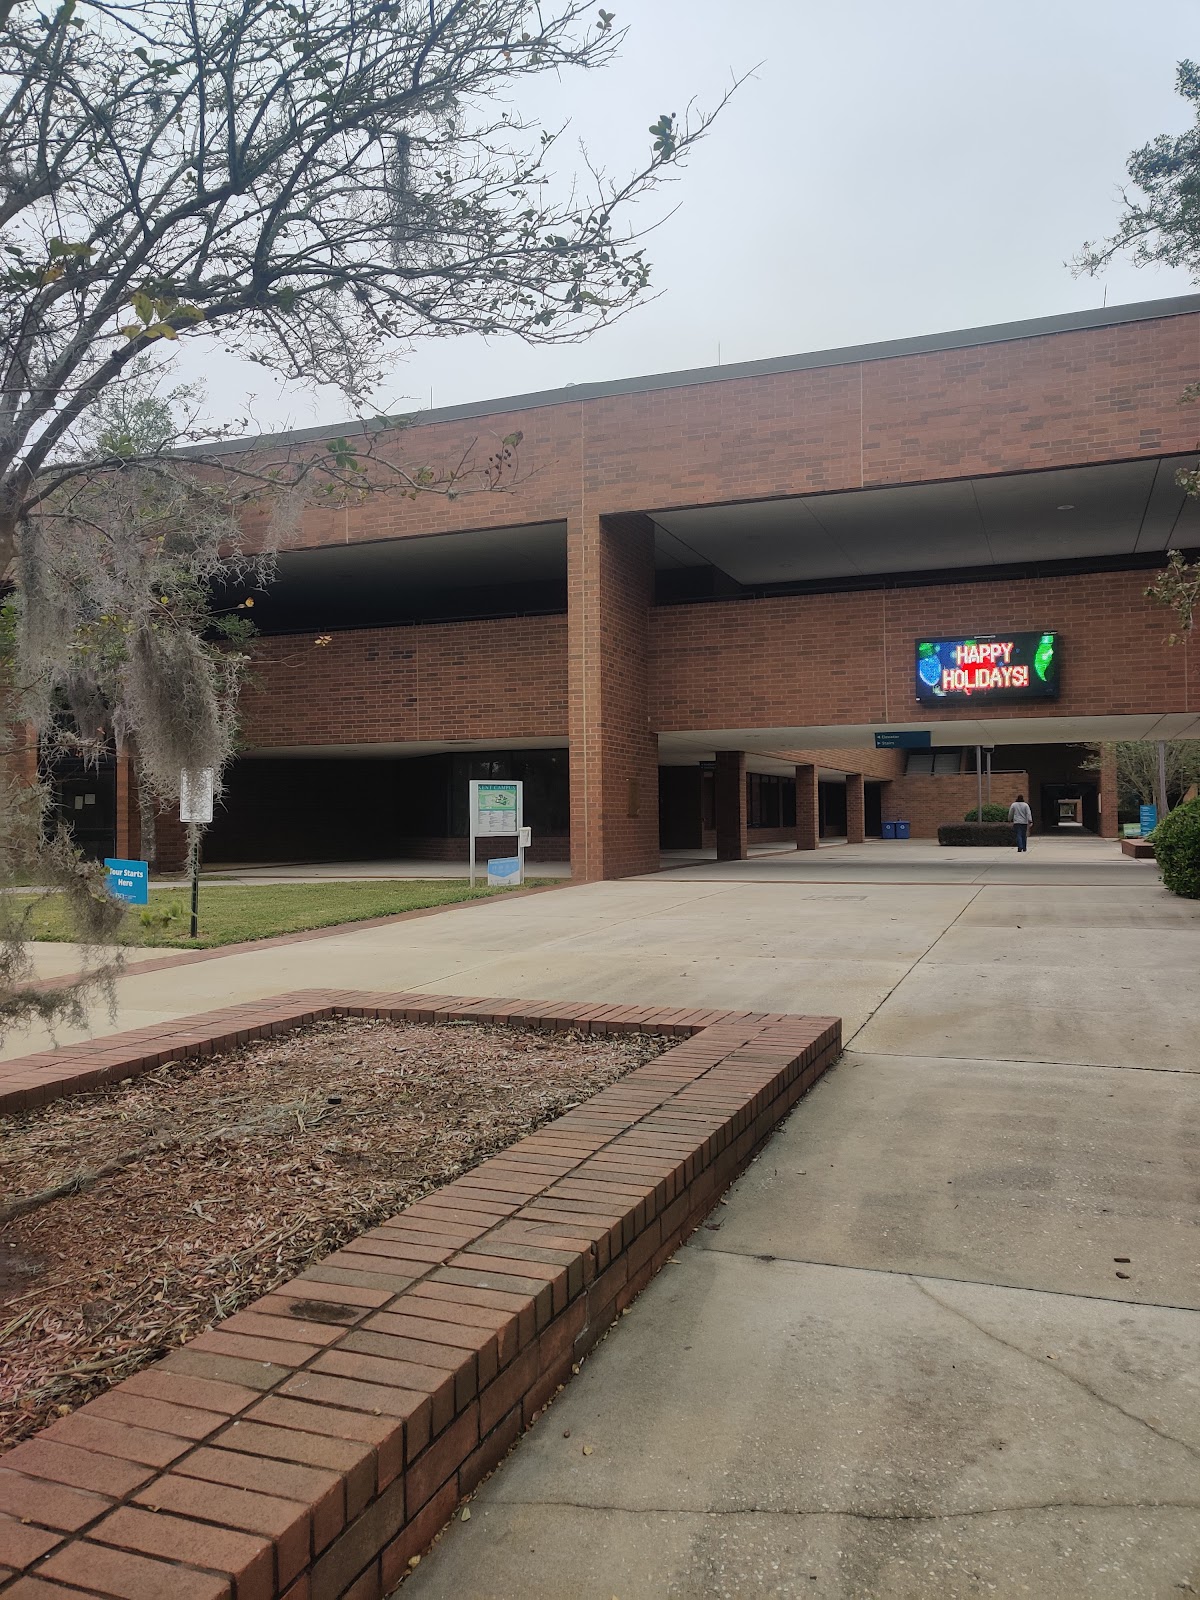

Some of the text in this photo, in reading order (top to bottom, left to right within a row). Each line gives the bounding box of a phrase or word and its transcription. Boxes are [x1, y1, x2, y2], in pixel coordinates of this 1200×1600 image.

[956, 642, 1014, 665] HAPPY
[942, 665, 1029, 689] HOLIDAYS!
[110, 868, 143, 878] Tour Starts
[118, 879, 133, 887] Here
